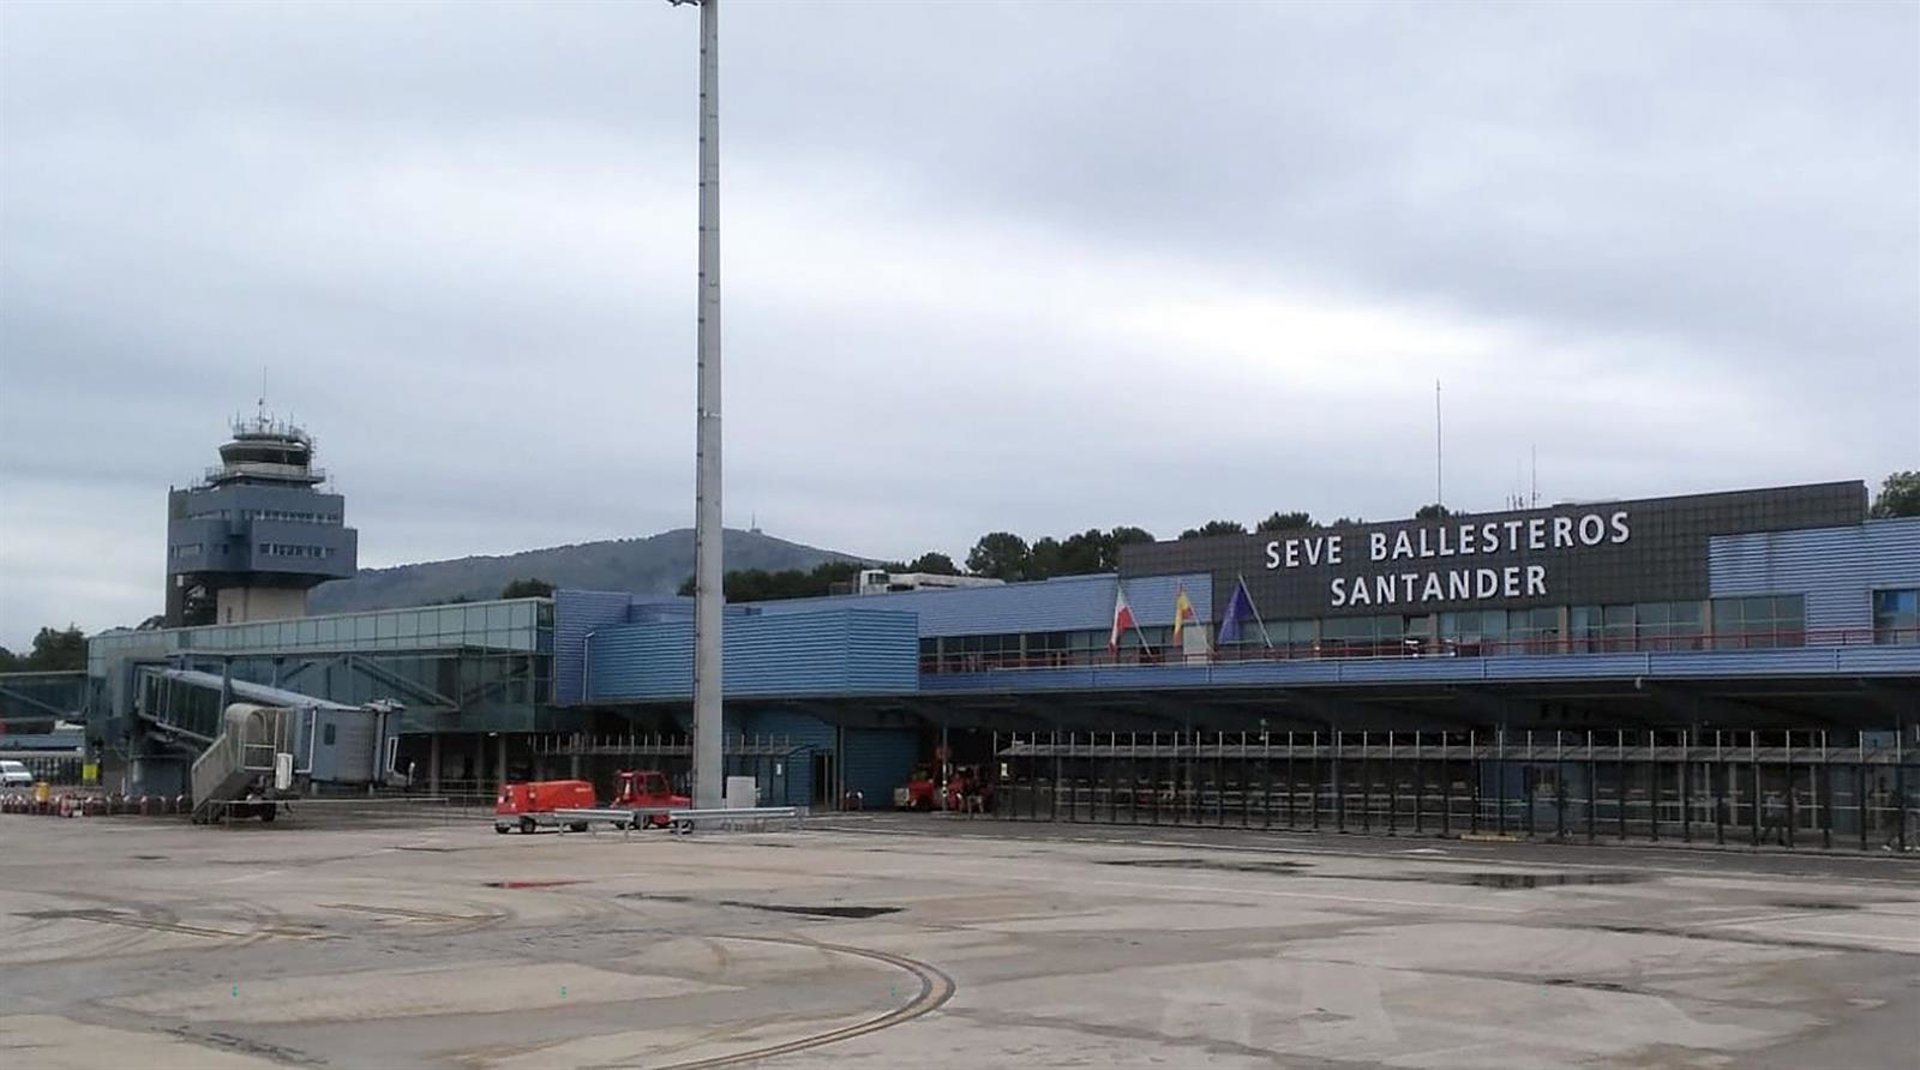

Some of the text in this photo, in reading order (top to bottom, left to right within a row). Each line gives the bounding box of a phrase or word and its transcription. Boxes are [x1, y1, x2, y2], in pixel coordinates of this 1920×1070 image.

[1266, 511, 1629, 569] SEVE BALLESTEROS
[1331, 565, 1547, 606] SANTANDER
